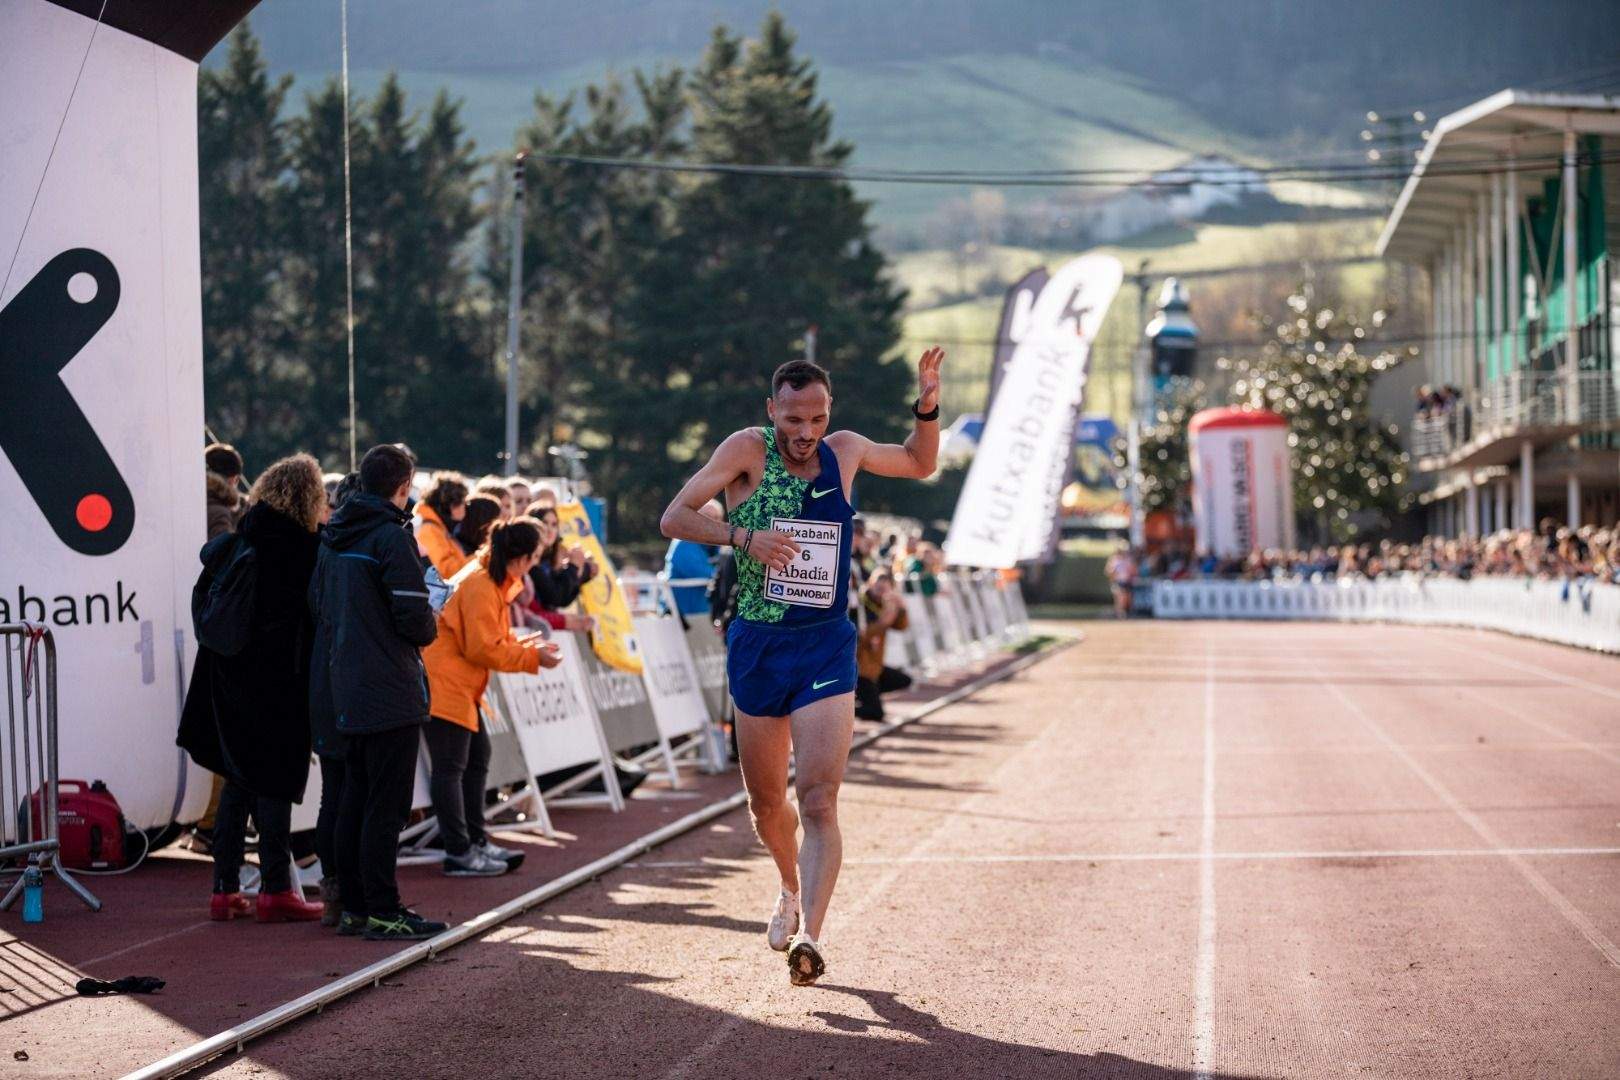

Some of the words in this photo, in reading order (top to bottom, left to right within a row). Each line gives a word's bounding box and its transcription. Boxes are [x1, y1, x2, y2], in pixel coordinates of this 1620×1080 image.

[775, 525, 836, 540] txabank
[801, 549, 811, 561] 6
[778, 564, 829, 581] Abadía
[786, 587, 831, 600] DANOBAT
